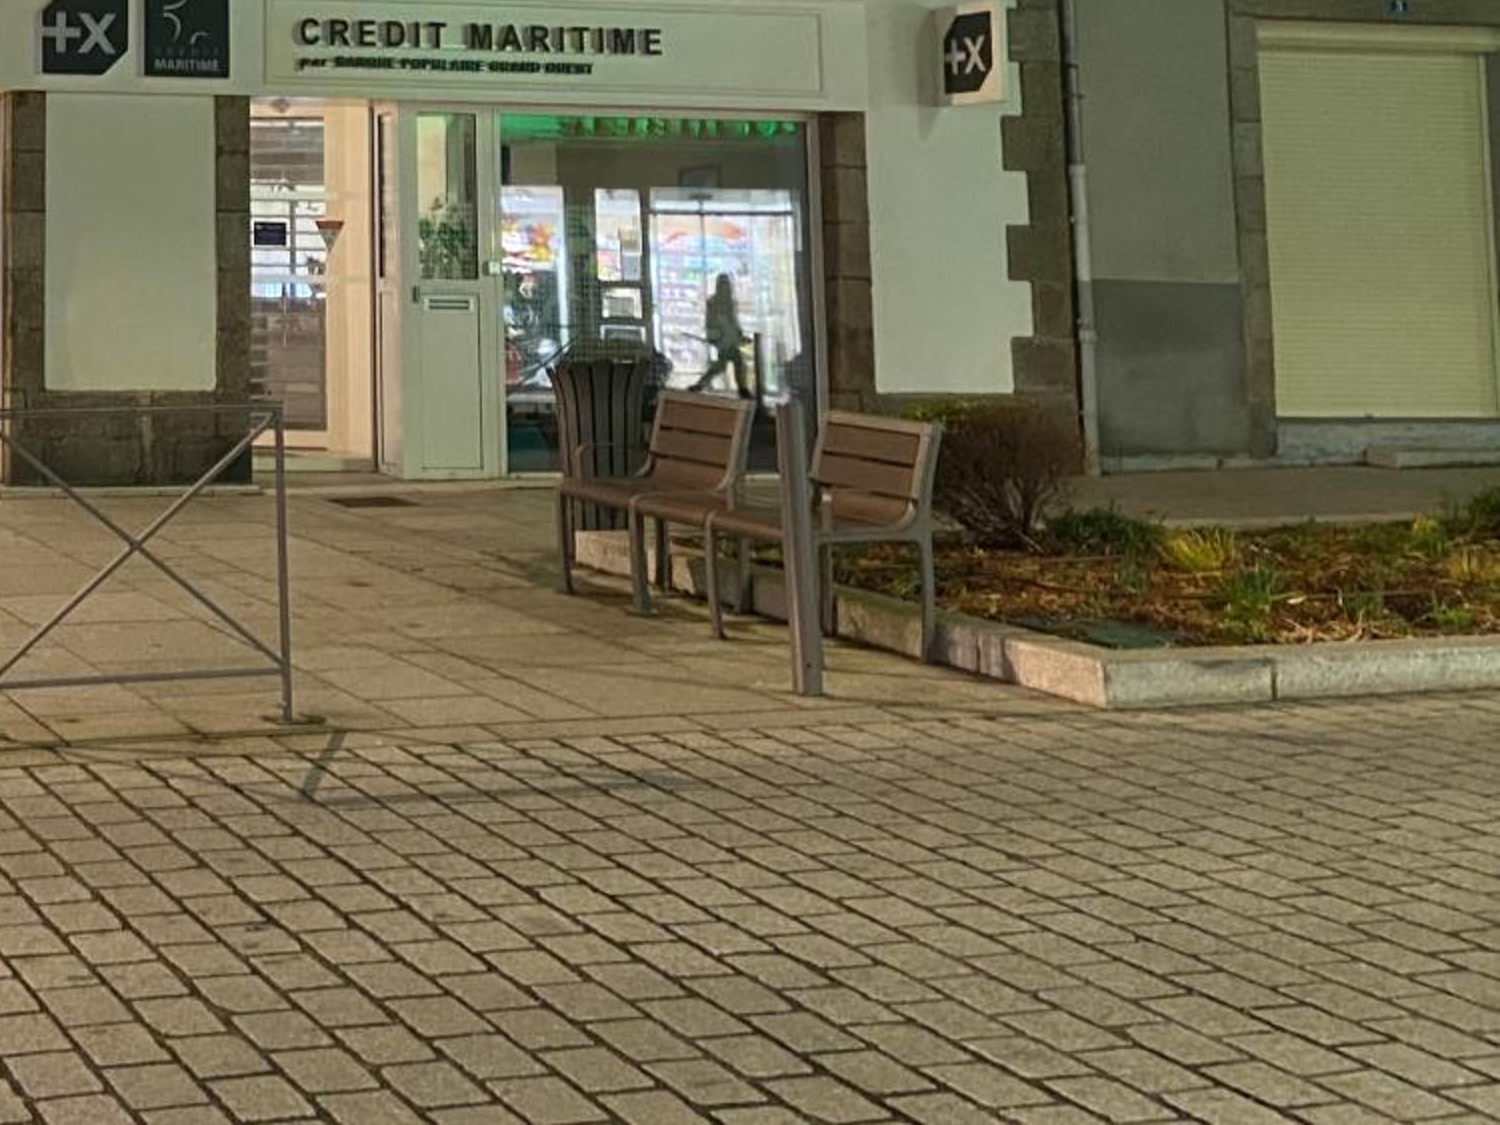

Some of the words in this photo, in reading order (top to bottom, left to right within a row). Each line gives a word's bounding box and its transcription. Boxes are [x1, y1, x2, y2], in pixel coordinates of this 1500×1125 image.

[299, 18, 448, 49] CREDIT
[469, 23, 663, 56] MARITIME
[154, 58, 220, 72] MARITIME
[334, 55, 396, 68] BANQUE
[399, 57, 484, 72] POPULAIRE
[488, 60, 541, 74] GRAND
[543, 62, 594, 75] OUEST
